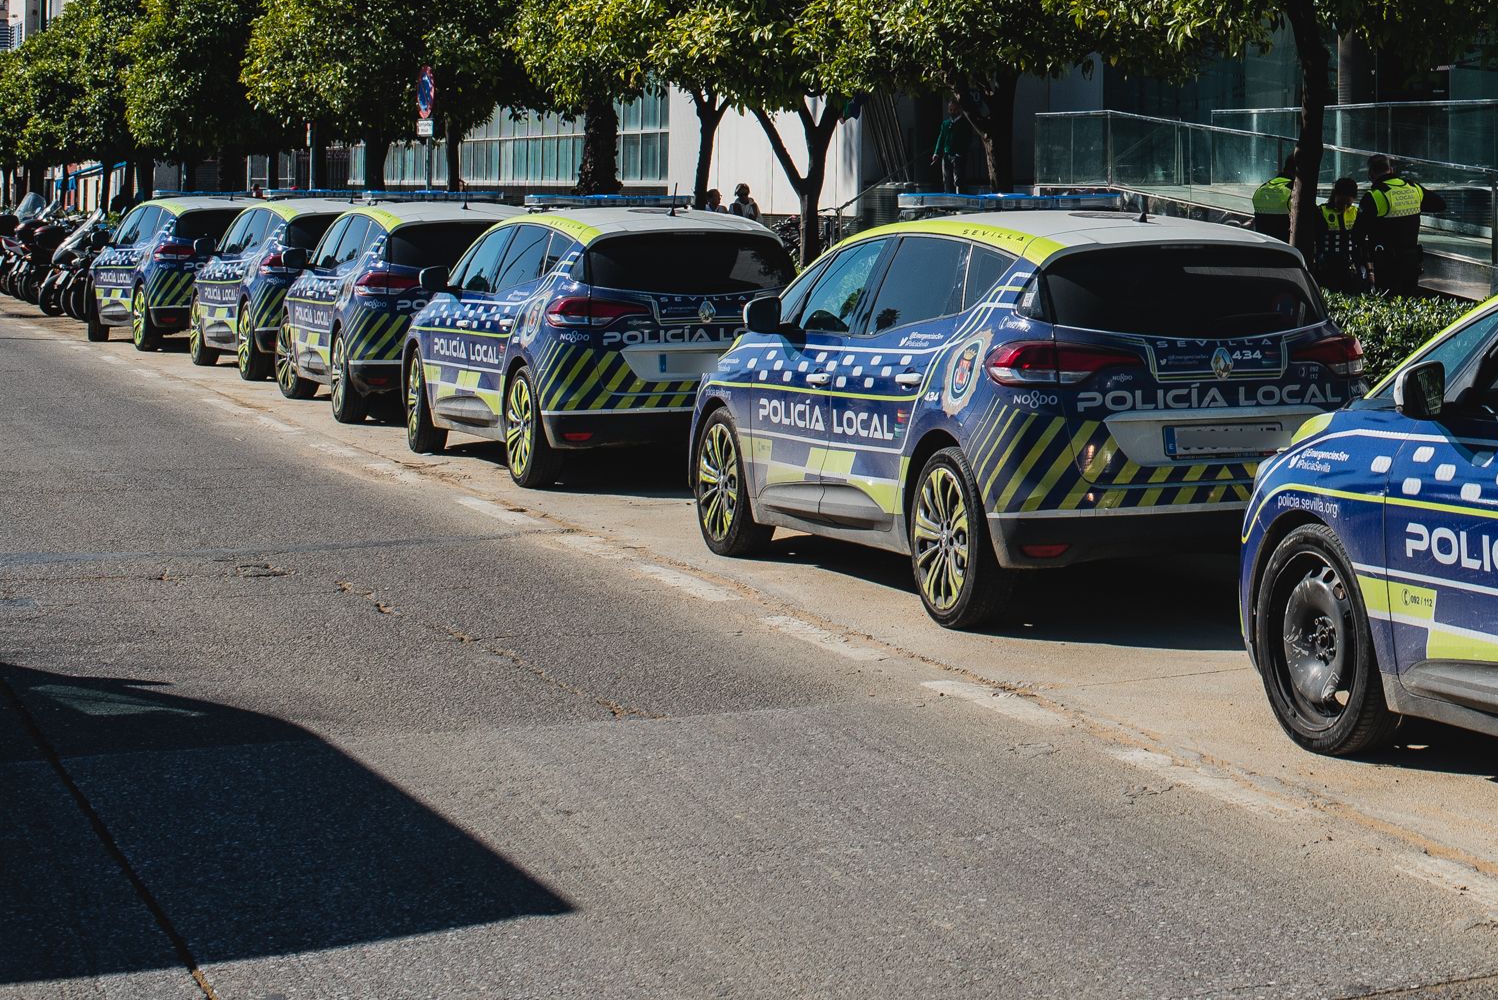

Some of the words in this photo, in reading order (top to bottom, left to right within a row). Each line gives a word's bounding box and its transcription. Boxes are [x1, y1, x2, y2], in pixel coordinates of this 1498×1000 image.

[962, 229, 1025, 242] SEVILLA
[603, 325, 712, 347] POLICÍA
[1156, 338, 1273, 349] SEVILLA
[433, 337, 467, 359] POLICÍA
[469, 343, 499, 364] LOCAL
[1232, 350, 1263, 361] 434
[924, 391, 940, 402] 434
[1076, 382, 1228, 412] POLICÍA
[1239, 384, 1342, 406] LOCAL
[759, 398, 826, 432] POLICÍA
[833, 409, 895, 441] LOCAL
[1301, 448, 1350, 462] @EmergenciasSev
[1277, 494, 1339, 518] policia.sevilla.org
